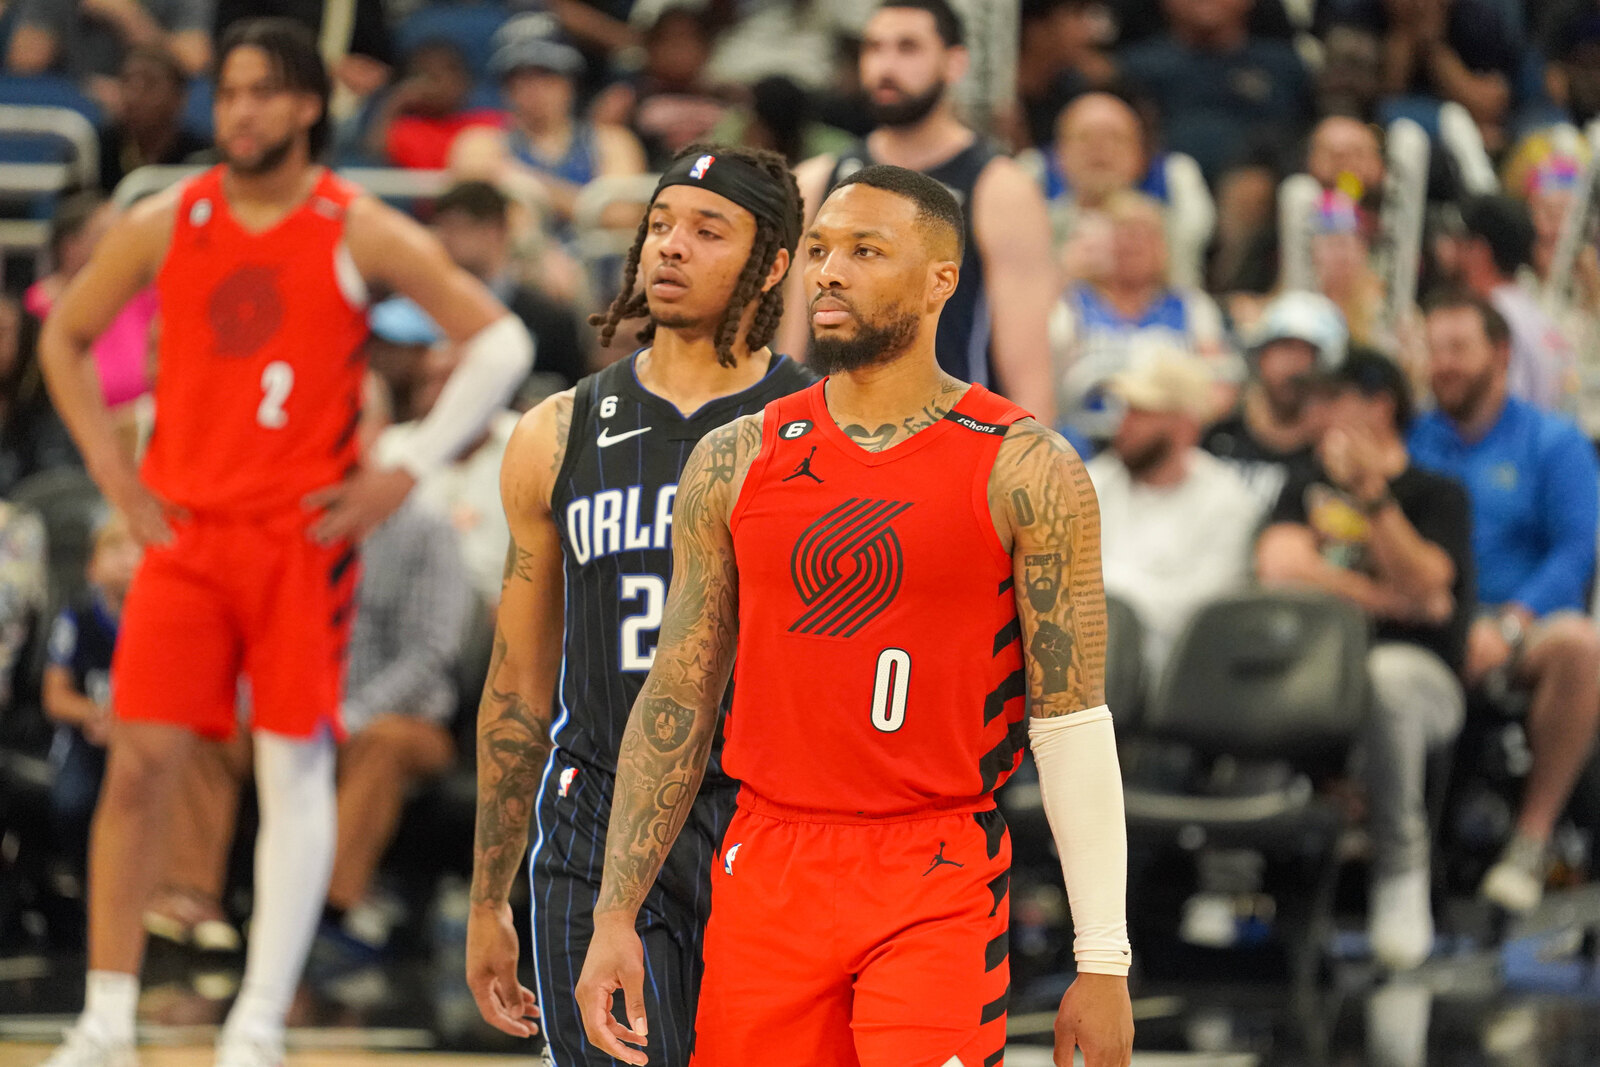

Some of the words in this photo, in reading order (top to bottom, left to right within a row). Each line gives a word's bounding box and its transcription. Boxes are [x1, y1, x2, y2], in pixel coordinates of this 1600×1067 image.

[257, 360, 294, 429] 2
[600, 395, 618, 418] 6
[784, 422, 807, 438] 6
[566, 484, 678, 566] ORLA
[619, 572, 667, 673] 2
[870, 647, 912, 733] 0
